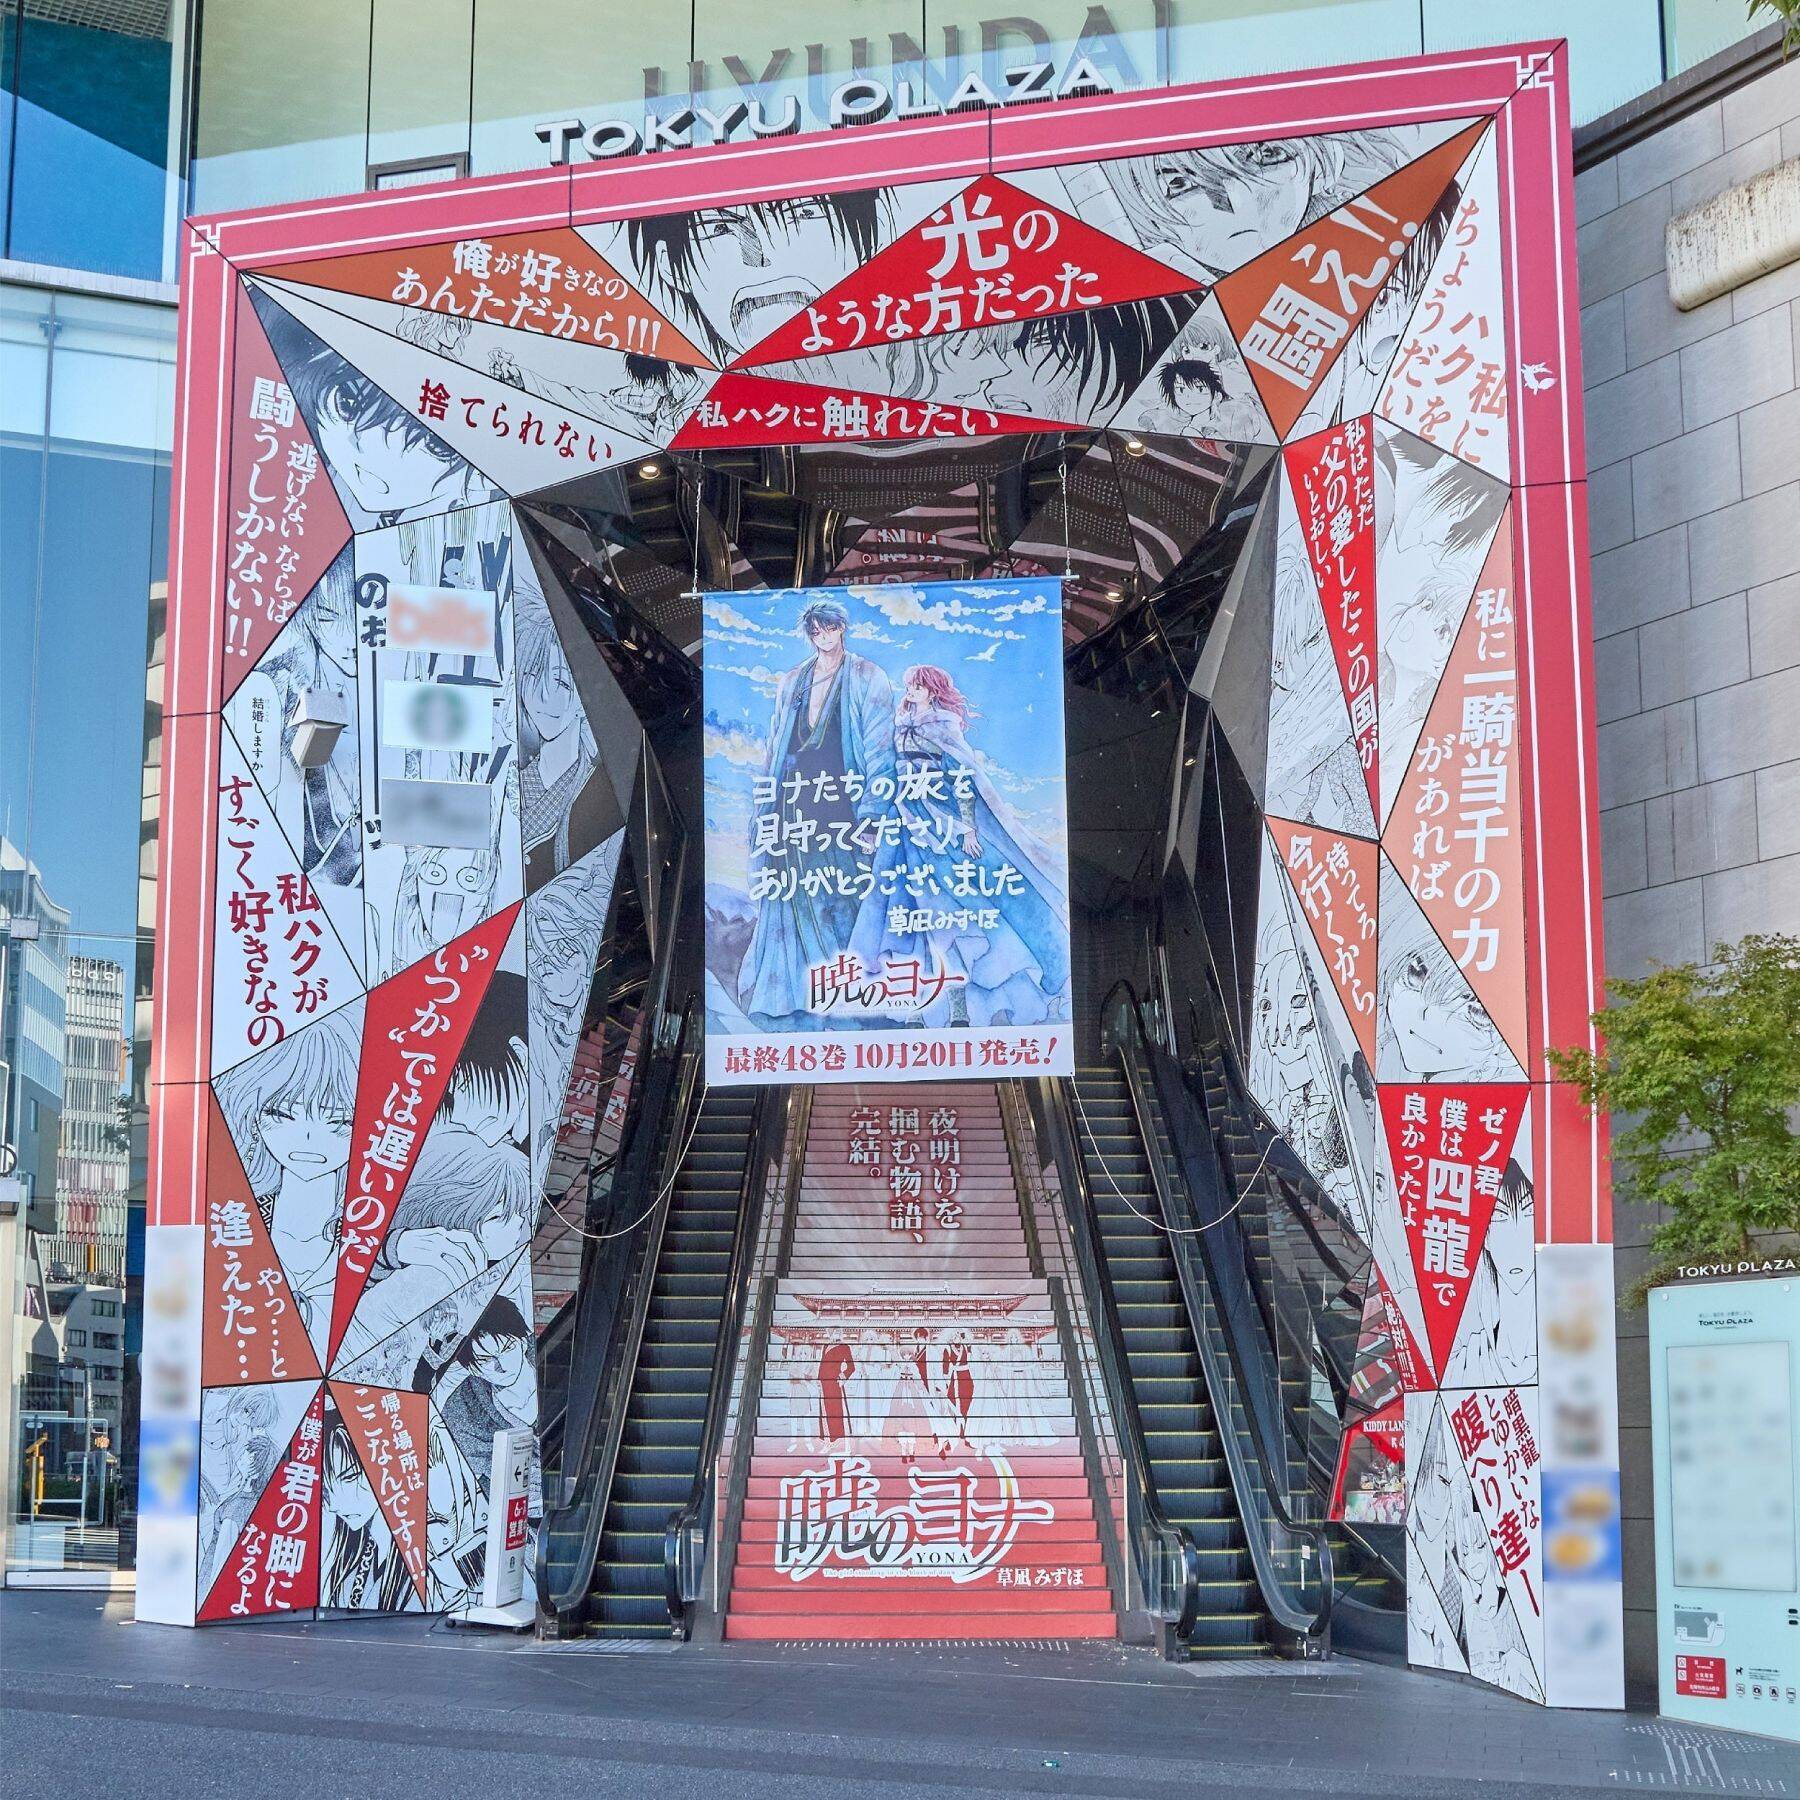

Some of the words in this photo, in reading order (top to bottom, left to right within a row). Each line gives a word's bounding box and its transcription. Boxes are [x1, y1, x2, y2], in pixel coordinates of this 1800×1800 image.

[534, 94, 801, 166] TOKYU
[830, 57, 1114, 129] PLAZA
[452, 239, 629, 301] 俺が好きなの
[920, 193, 1060, 281] 光の
[799, 261, 1104, 353] ような方だった
[1381, 198, 1482, 421] ちょうだい
[418, 378, 613, 462] 捨てられない
[1420, 310, 1490, 442] ハクを
[1468, 360, 1508, 465] 私に
[1303, 465, 1333, 590] いとおしい
[1344, 419, 1375, 535] 私はただ
[1319, 435, 1380, 771] 父の愛したこの国が
[751, 763, 977, 805] ヨナたちの旅を
[1410, 731, 1455, 902] があれば
[1451, 586, 1517, 973] 私に一騎当千の力
[749, 859, 1026, 902] ありがとうございました
[750, 811, 957, 859] 見守ってくださり
[219, 775, 286, 1047] すごく好きなの
[1287, 834, 1375, 1016] 今行くから
[1326, 840, 1378, 941] 待ってろ
[276, 873, 328, 1014] 私ハクが
[810, 953, 965, 1012] 暁のヨナ
[886, 1000, 918, 1008] YONA
[848, 1106, 882, 1178] 完結。
[928, 1107, 964, 1230] 夜明けを
[1399, 1091, 1431, 1228] 良かったよ
[1473, 1105, 1509, 1198] ゼノ君
[1421, 1096, 1474, 1308] 僕は四龍で
[1678, 1263, 1733, 1279] TOKYU
[1737, 1258, 1797, 1274] PLAZA
[381, 1392, 425, 1492] 帰る場所は
[1363, 1420, 1388, 1433] KIDDY
[1484, 1394, 1541, 1530] とゆかいな
[1502, 1388, 1541, 1471] 暗黒龍
[774, 1446, 1055, 1584] 暁のヨナ
[916, 1550, 970, 1565] YONA
[230, 1523, 266, 1616] なるよ
